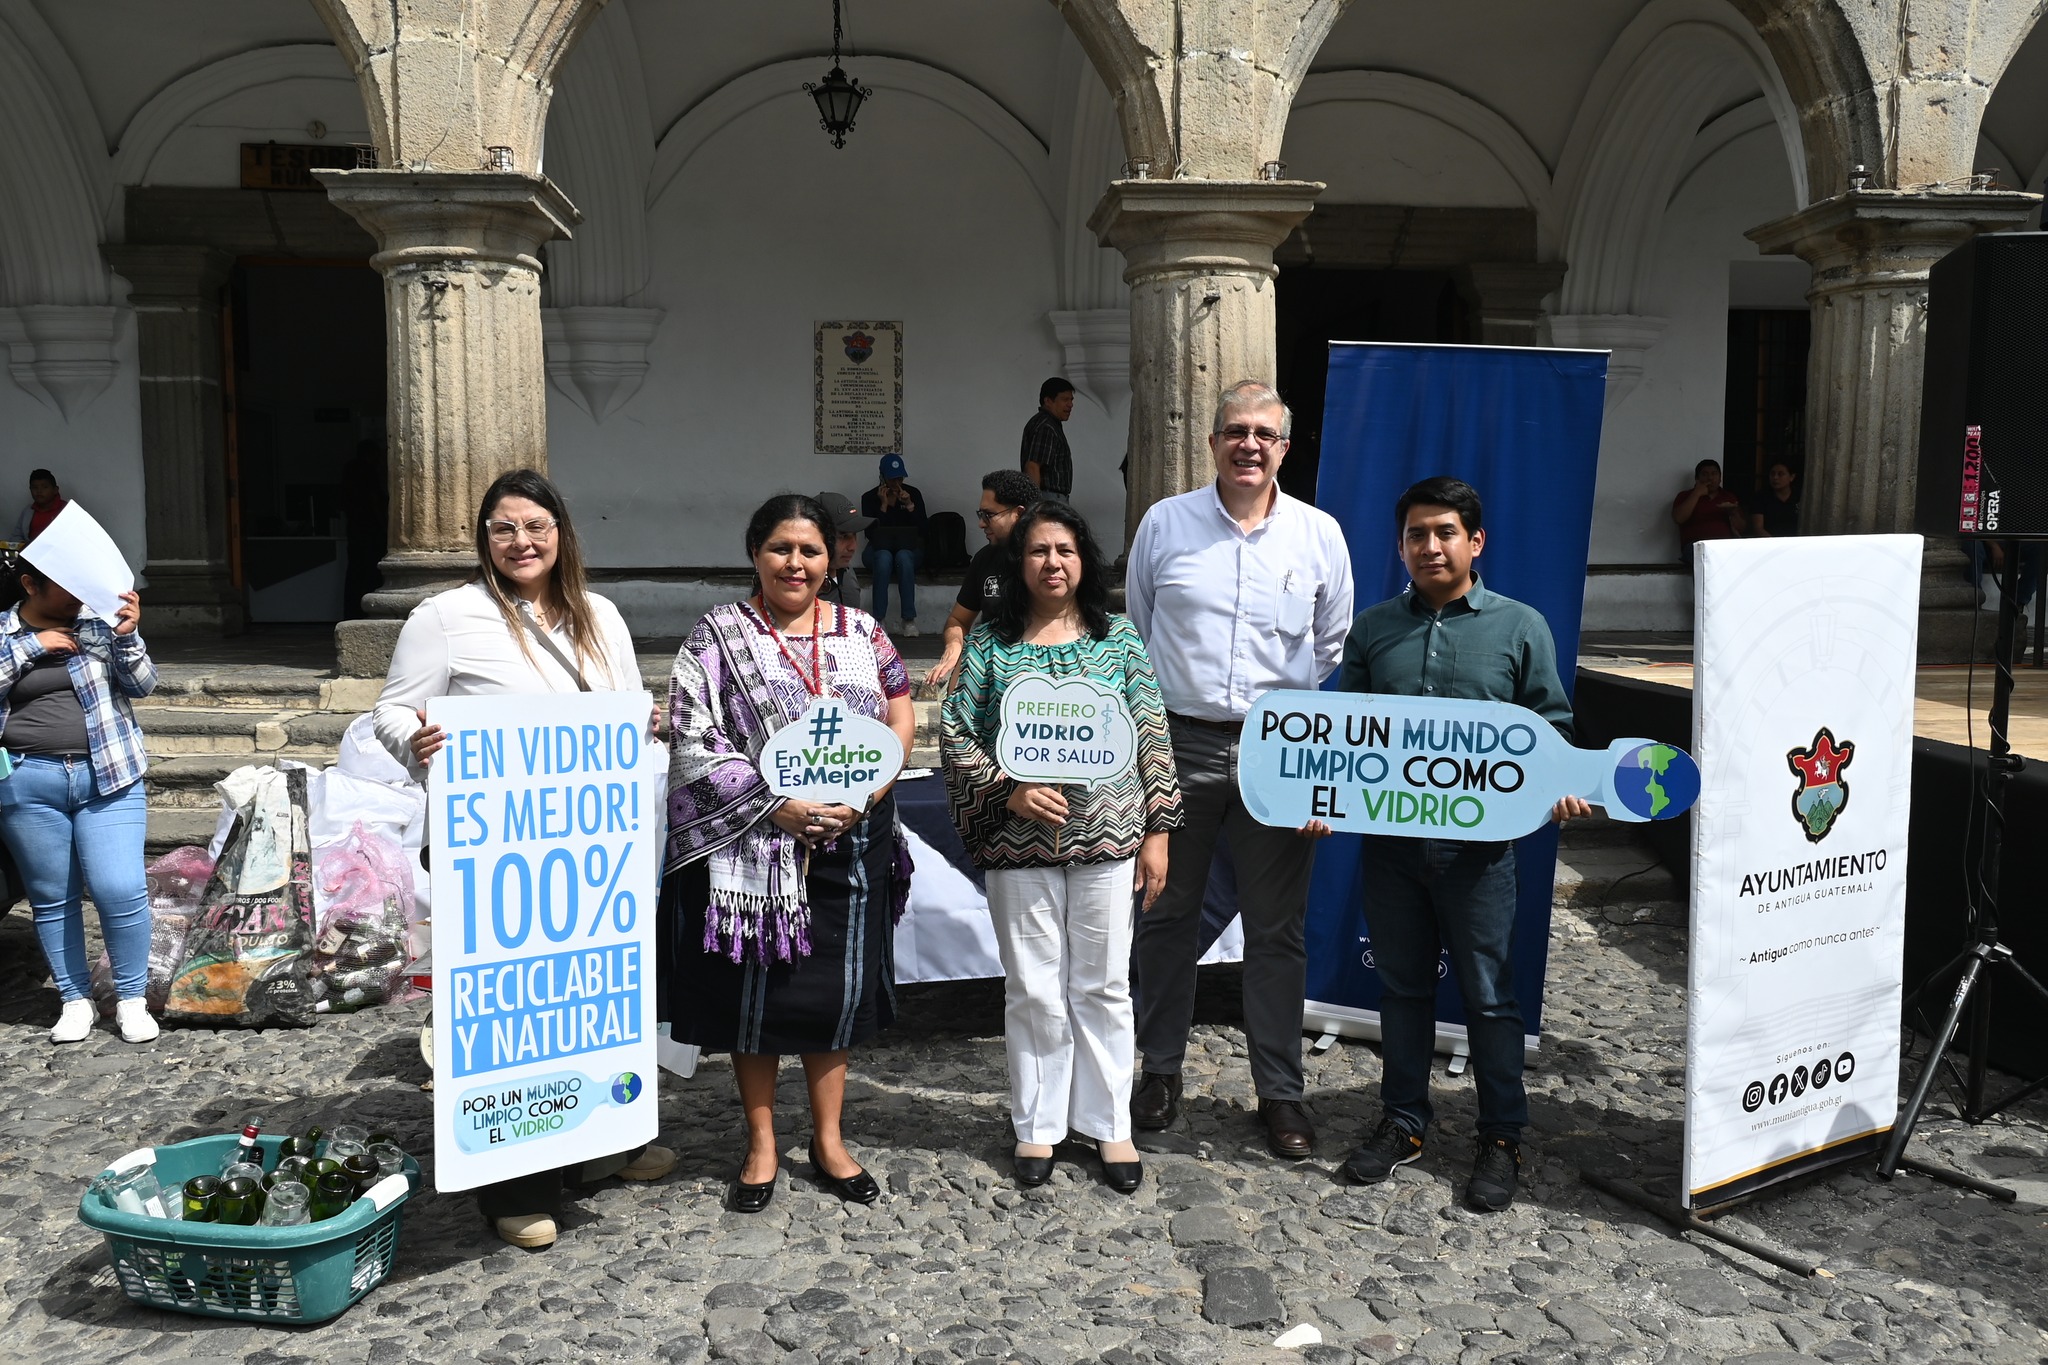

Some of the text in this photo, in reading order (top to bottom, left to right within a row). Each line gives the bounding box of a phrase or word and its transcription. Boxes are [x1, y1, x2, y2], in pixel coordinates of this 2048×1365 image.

[1964, 438, 1980, 481] 1200
[1986, 490, 2000, 531] OPERA
[808, 707, 843, 746] #
[1017, 701, 1096, 718] PREFIERO
[1015, 723, 1094, 742] VIDRIO
[1261, 710, 1537, 756] POR UN MUNDO
[445, 722, 639, 783] ¡EN VIDRIO
[775, 744, 882, 769] EnVidrio
[1014, 747, 1115, 765] POR SALUD
[1279, 747, 1525, 793] LIMPIO COMO
[779, 763, 880, 789] EsMejor
[446, 781, 639, 848] ES MEJOR!
[1311, 785, 1485, 828] EL VIDRIO
[1739, 849, 1887, 898] AYUNTAMIENTO
[453, 841, 637, 955] 100%
[1757, 882, 1873, 914] DE ANTIGUA GUATEMALA
[1749, 926, 1875, 964] Antigua como nunca antes
[267, 980, 296, 990] 23%
[454, 946, 638, 1020] RECICLABLE
[456, 996, 639, 1071] Y NATURAL
[1816, 1041, 1831, 1051] en:
[463, 1077, 582, 1115] POR UN MUNDO
[473, 1094, 579, 1130] LIMPIO COMO
[1750, 1095, 1843, 1132] www.muniantigua.gob.gt
[489, 1114, 564, 1144] EL VIDRIO
